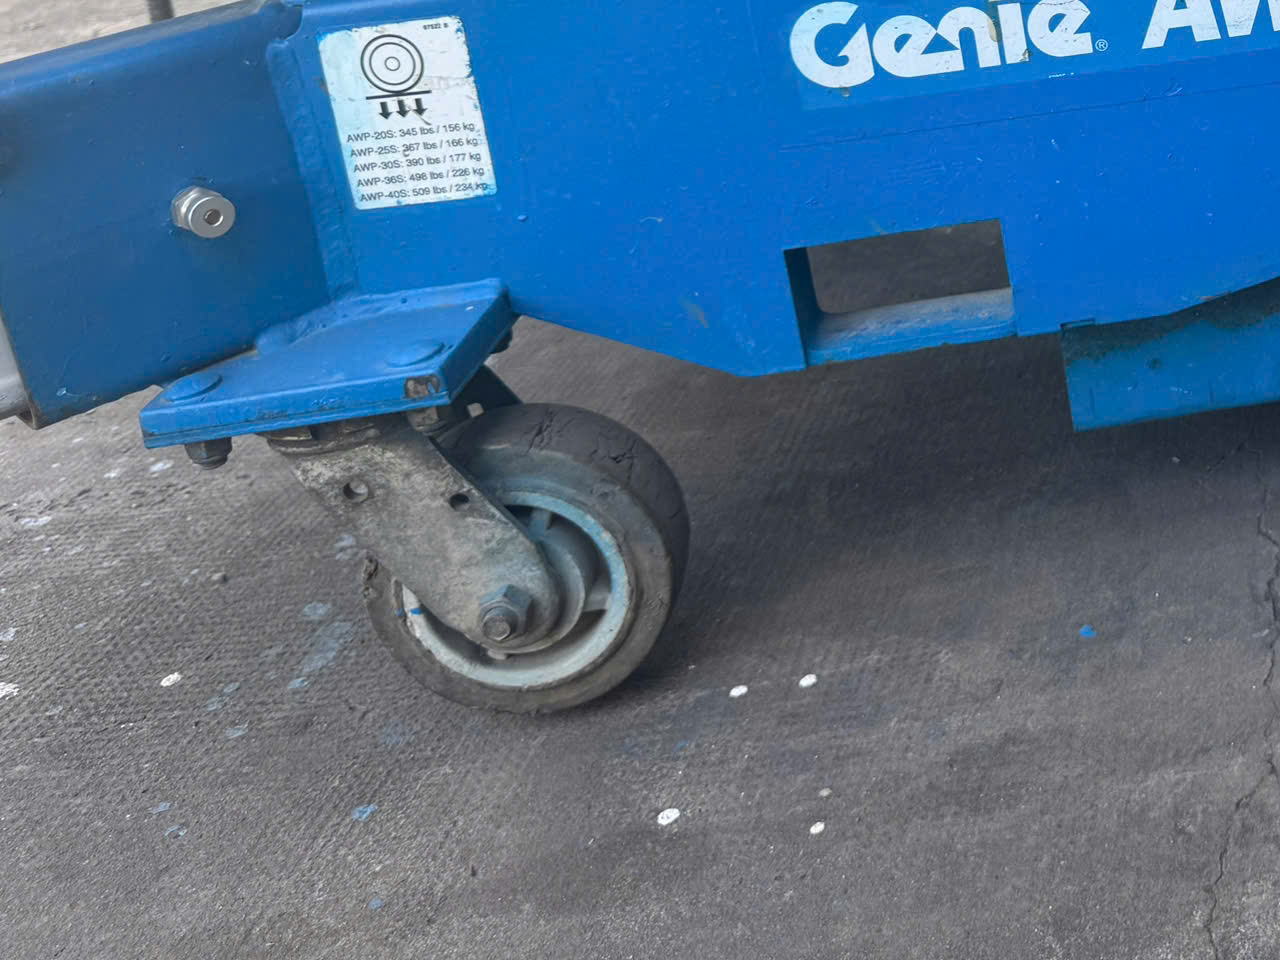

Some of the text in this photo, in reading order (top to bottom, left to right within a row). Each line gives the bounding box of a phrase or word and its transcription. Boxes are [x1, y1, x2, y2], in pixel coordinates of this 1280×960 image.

[346, 130, 397, 143] AWP-20S:
[399, 128, 417, 137] 345
[420, 126, 435, 135] lbs
[442, 123, 461, 133] 156
[463, 122, 475, 132] kg
[350, 145, 401, 158] AWP-25S:
[402, 142, 420, 152] 367
[423, 141, 438, 150] lbs
[446, 138, 464, 147] 166
[466, 137, 478, 147] kg
[353, 160, 404, 173] AWP-30S:
[405, 157, 424, 167] 390
[426, 157, 441, 165] lbs
[449, 153, 466, 162] 177
[469, 152, 481, 162] kg
[357, 174, 407, 187] AWP-36S:
[409, 172, 428, 181] 498
[430, 171, 444, 180] lbs
[451, 168, 471, 177] 226
[472, 167, 485, 176] kg
[360, 189, 411, 202] AWP-40S:
[412, 187, 430, 196] 509
[433, 186, 448, 194] lbs
[455, 183, 473, 192] 234
[475, 182, 488, 191] kg
